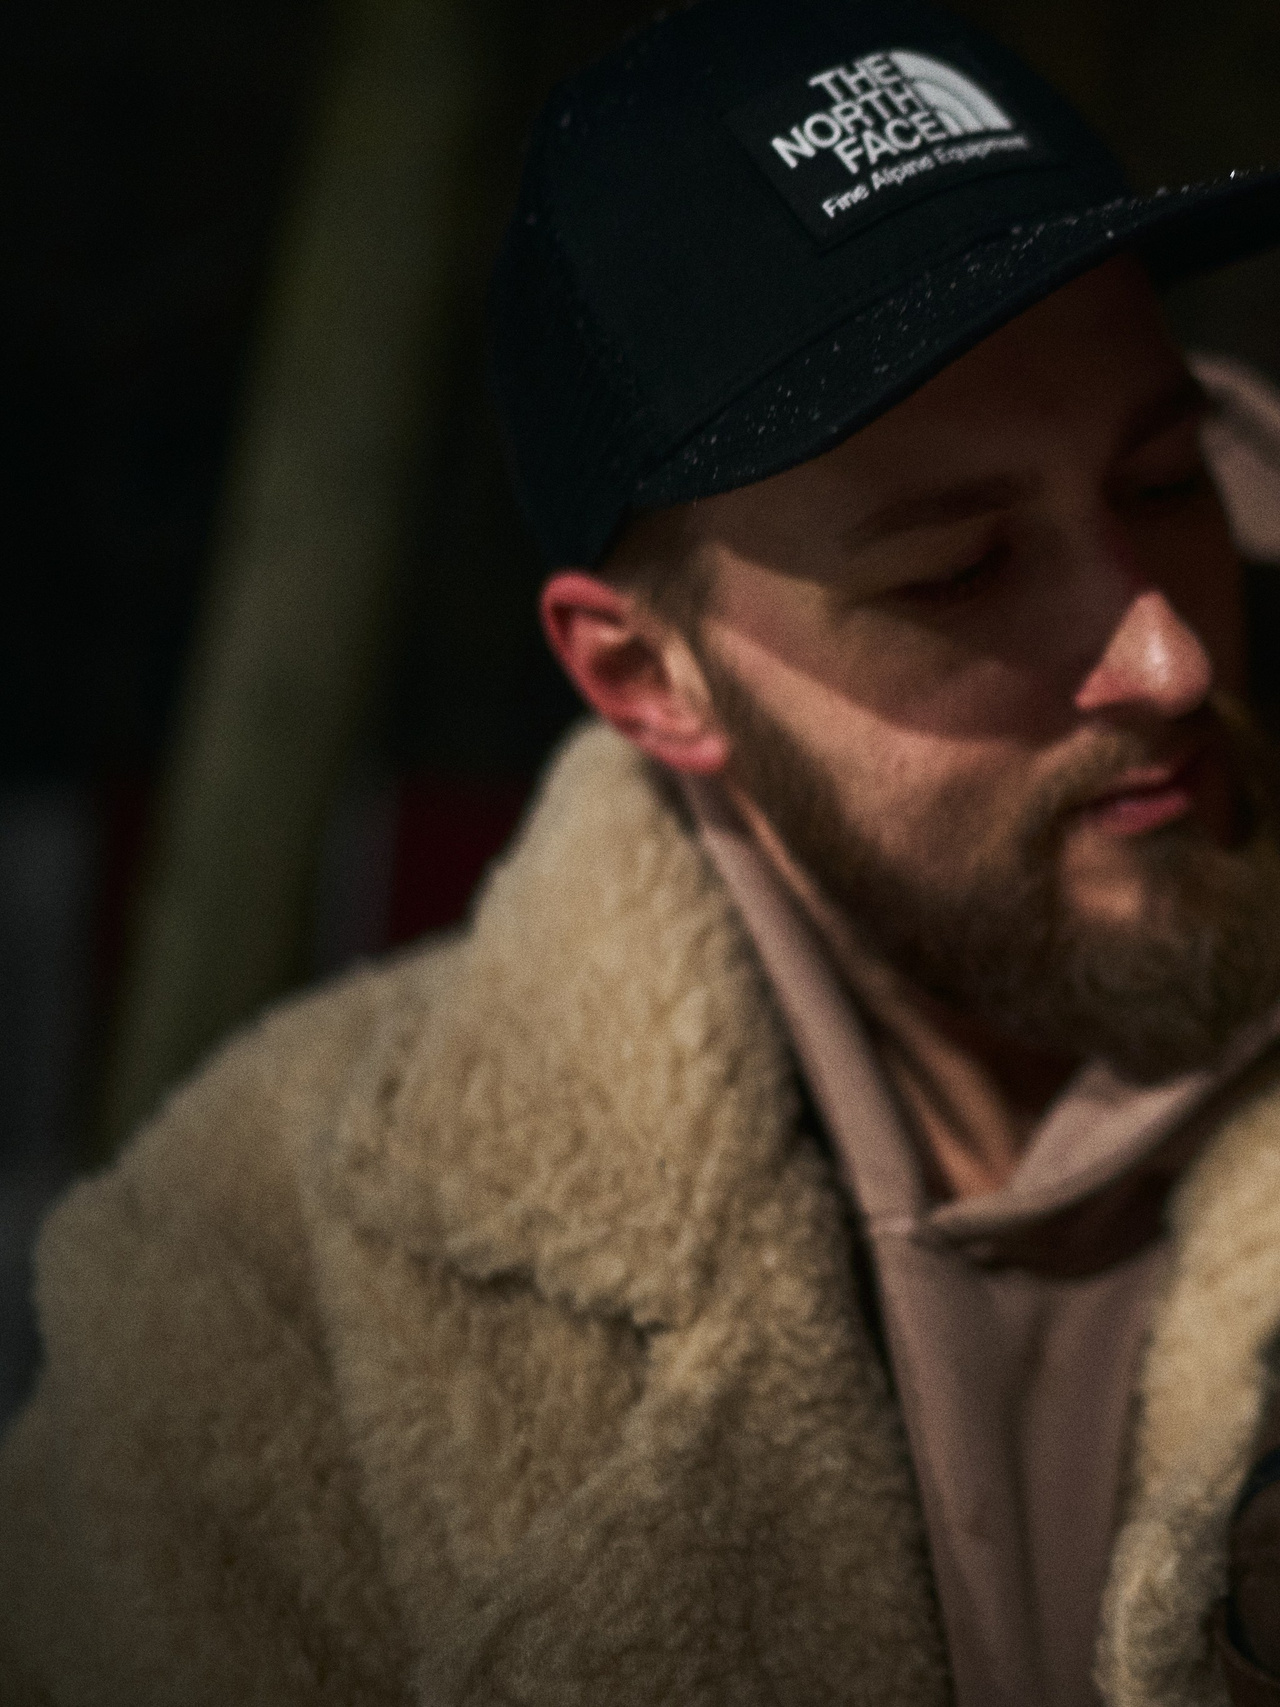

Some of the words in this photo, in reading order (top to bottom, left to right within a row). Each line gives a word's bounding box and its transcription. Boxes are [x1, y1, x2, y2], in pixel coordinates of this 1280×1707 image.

[807, 52, 901, 102] THE
[770, 82, 931, 169] NORTH
[833, 109, 949, 175] FACE
[821, 183, 870, 219] Fine
[870, 153, 936, 191] Alpine
[932, 135, 1029, 165] Equip
